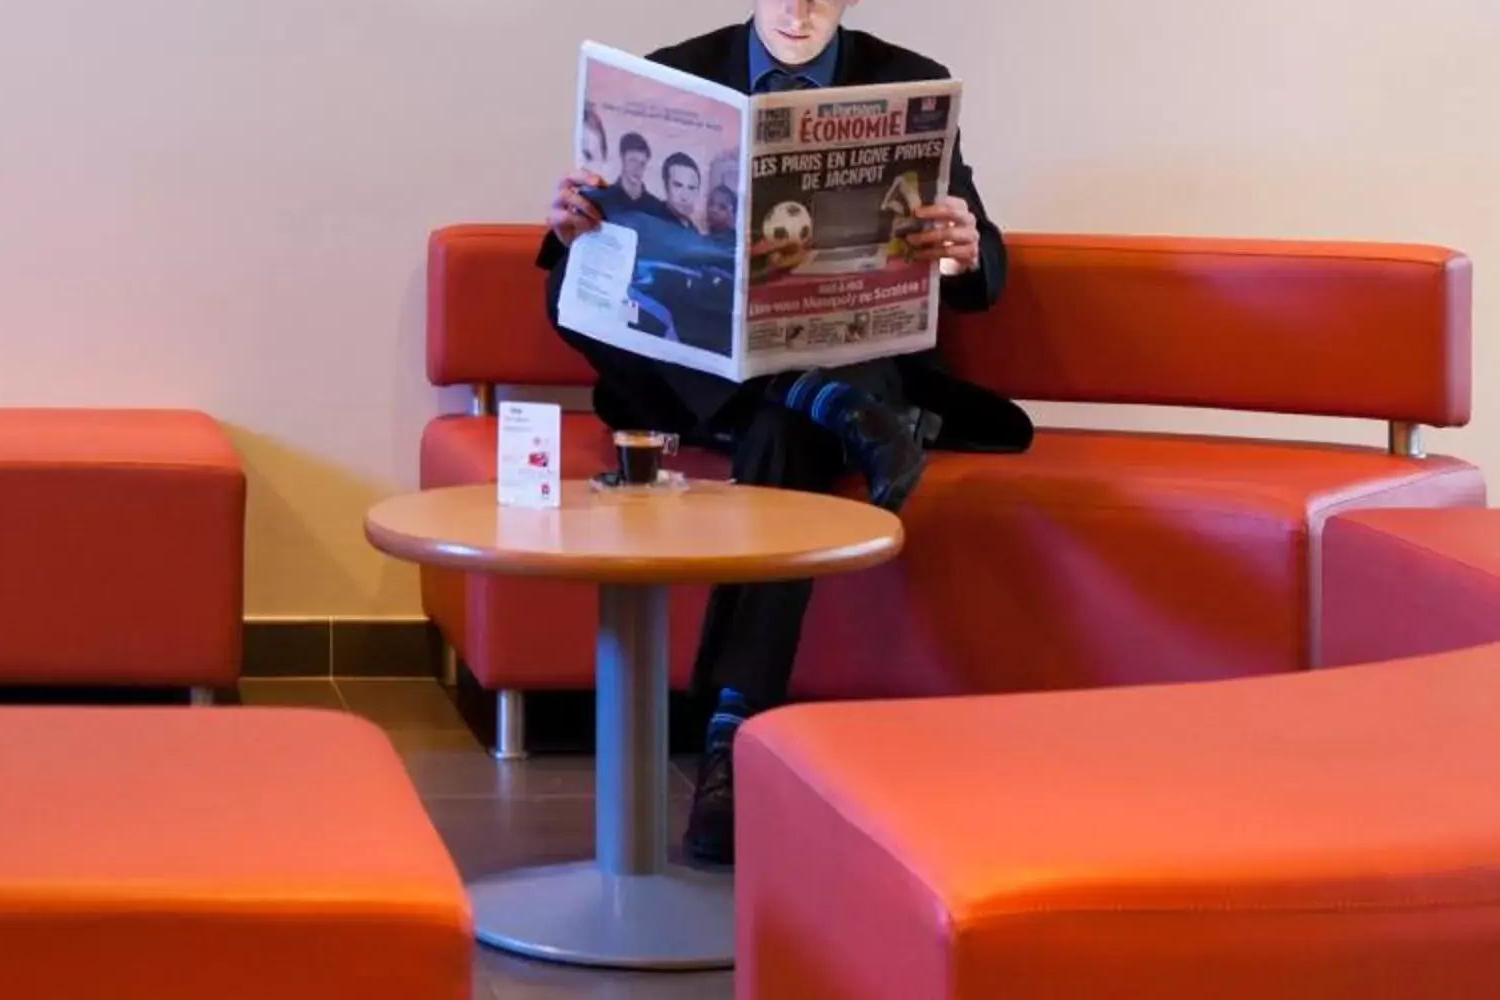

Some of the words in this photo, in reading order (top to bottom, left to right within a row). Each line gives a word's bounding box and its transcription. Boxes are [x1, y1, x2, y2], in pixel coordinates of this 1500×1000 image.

[799, 109, 903, 144] ÉCONOMIE
[752, 156, 778, 179] LES
[781, 152, 823, 174] PARIS
[826, 150, 846, 169] EN
[849, 146, 892, 167] LIGNE
[801, 172, 822, 191] DE
[824, 164, 885, 188] JACKPOT
